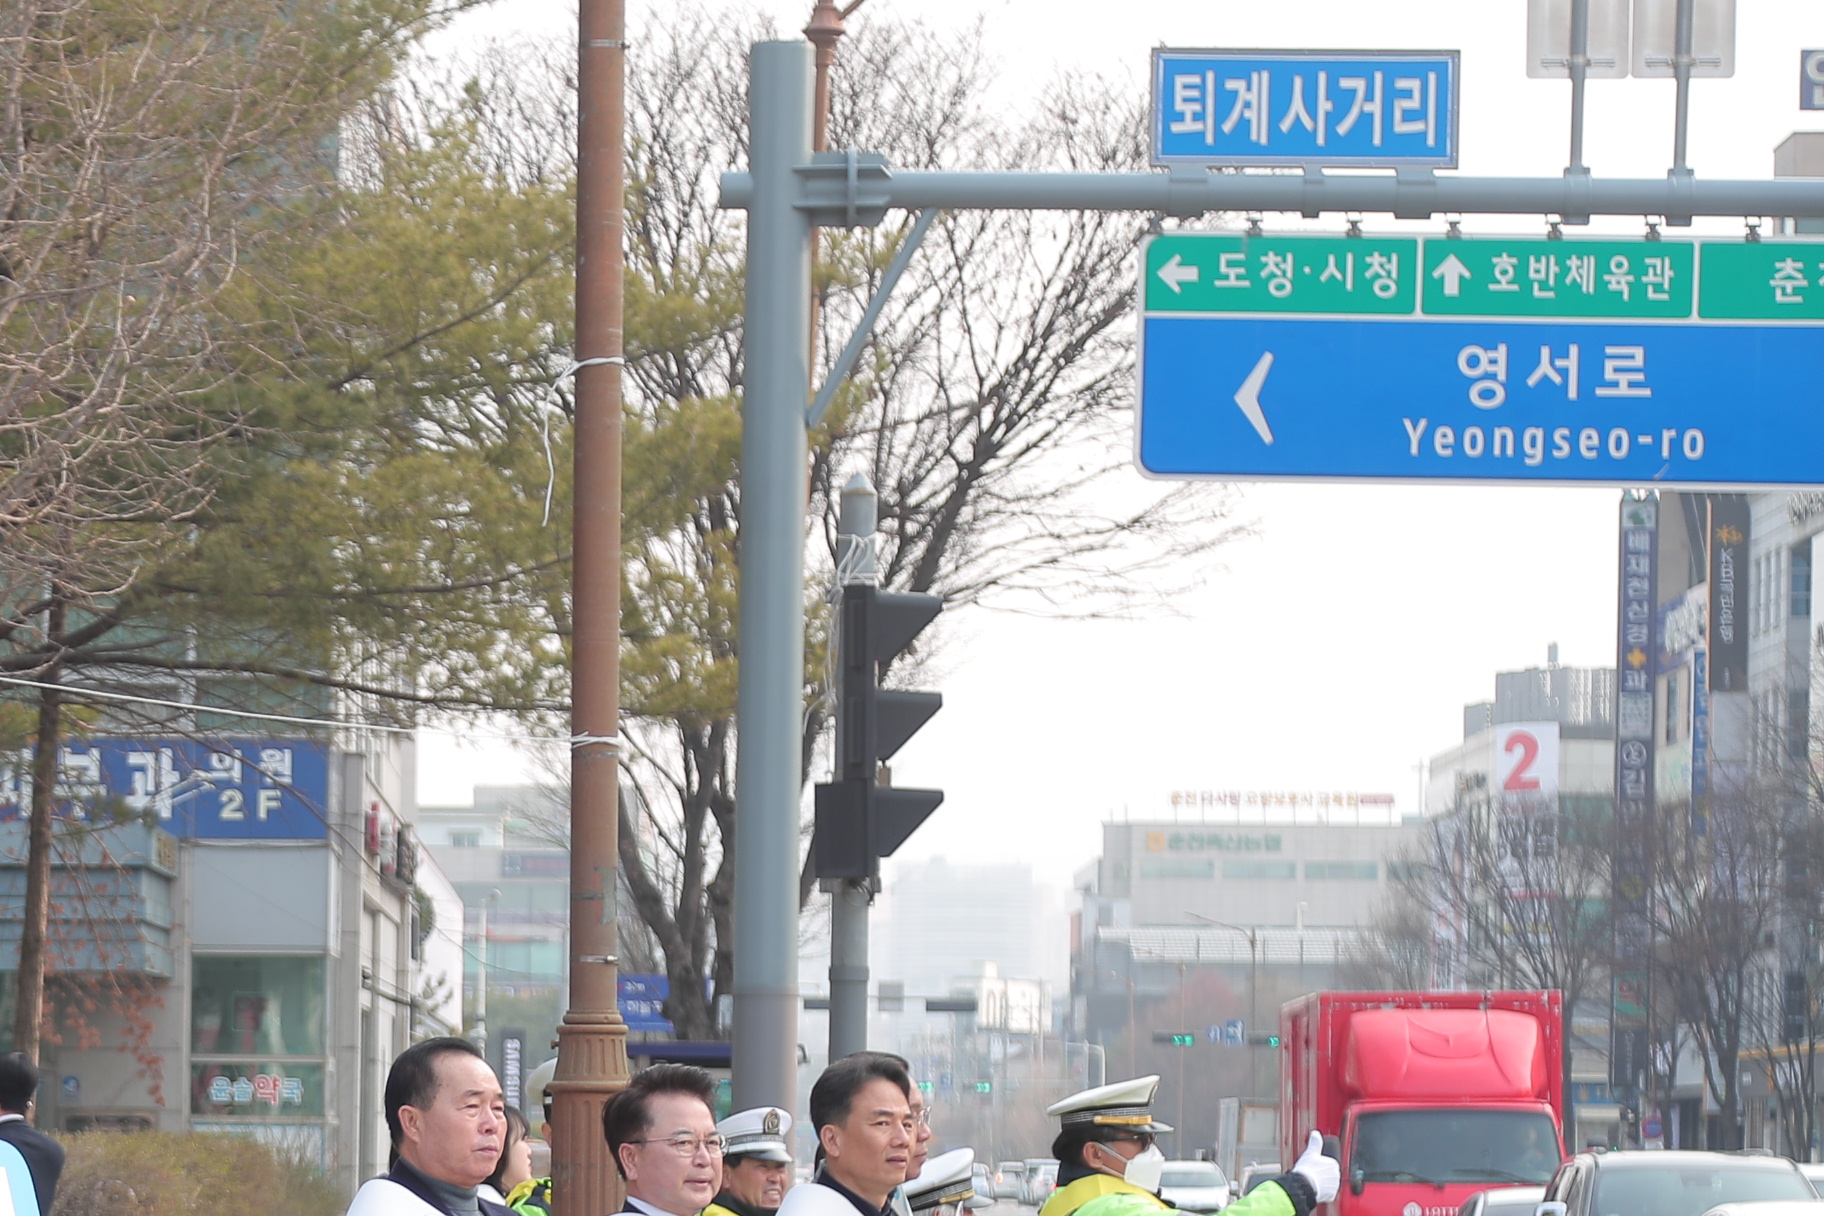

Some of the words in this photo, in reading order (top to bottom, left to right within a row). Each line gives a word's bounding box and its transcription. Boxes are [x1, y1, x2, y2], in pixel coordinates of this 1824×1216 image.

[1169, 70, 1437, 148] 퇴계사거리
[1214, 251, 1399, 299] 도청·시청
[1487, 252, 1675, 302] 호반체육관
[1457, 343, 1652, 410] 영서로
[1402, 418, 1705, 465] Yeongseo-ro
[1504, 730, 1540, 790] 2
[219, 789, 283, 820] 2F
